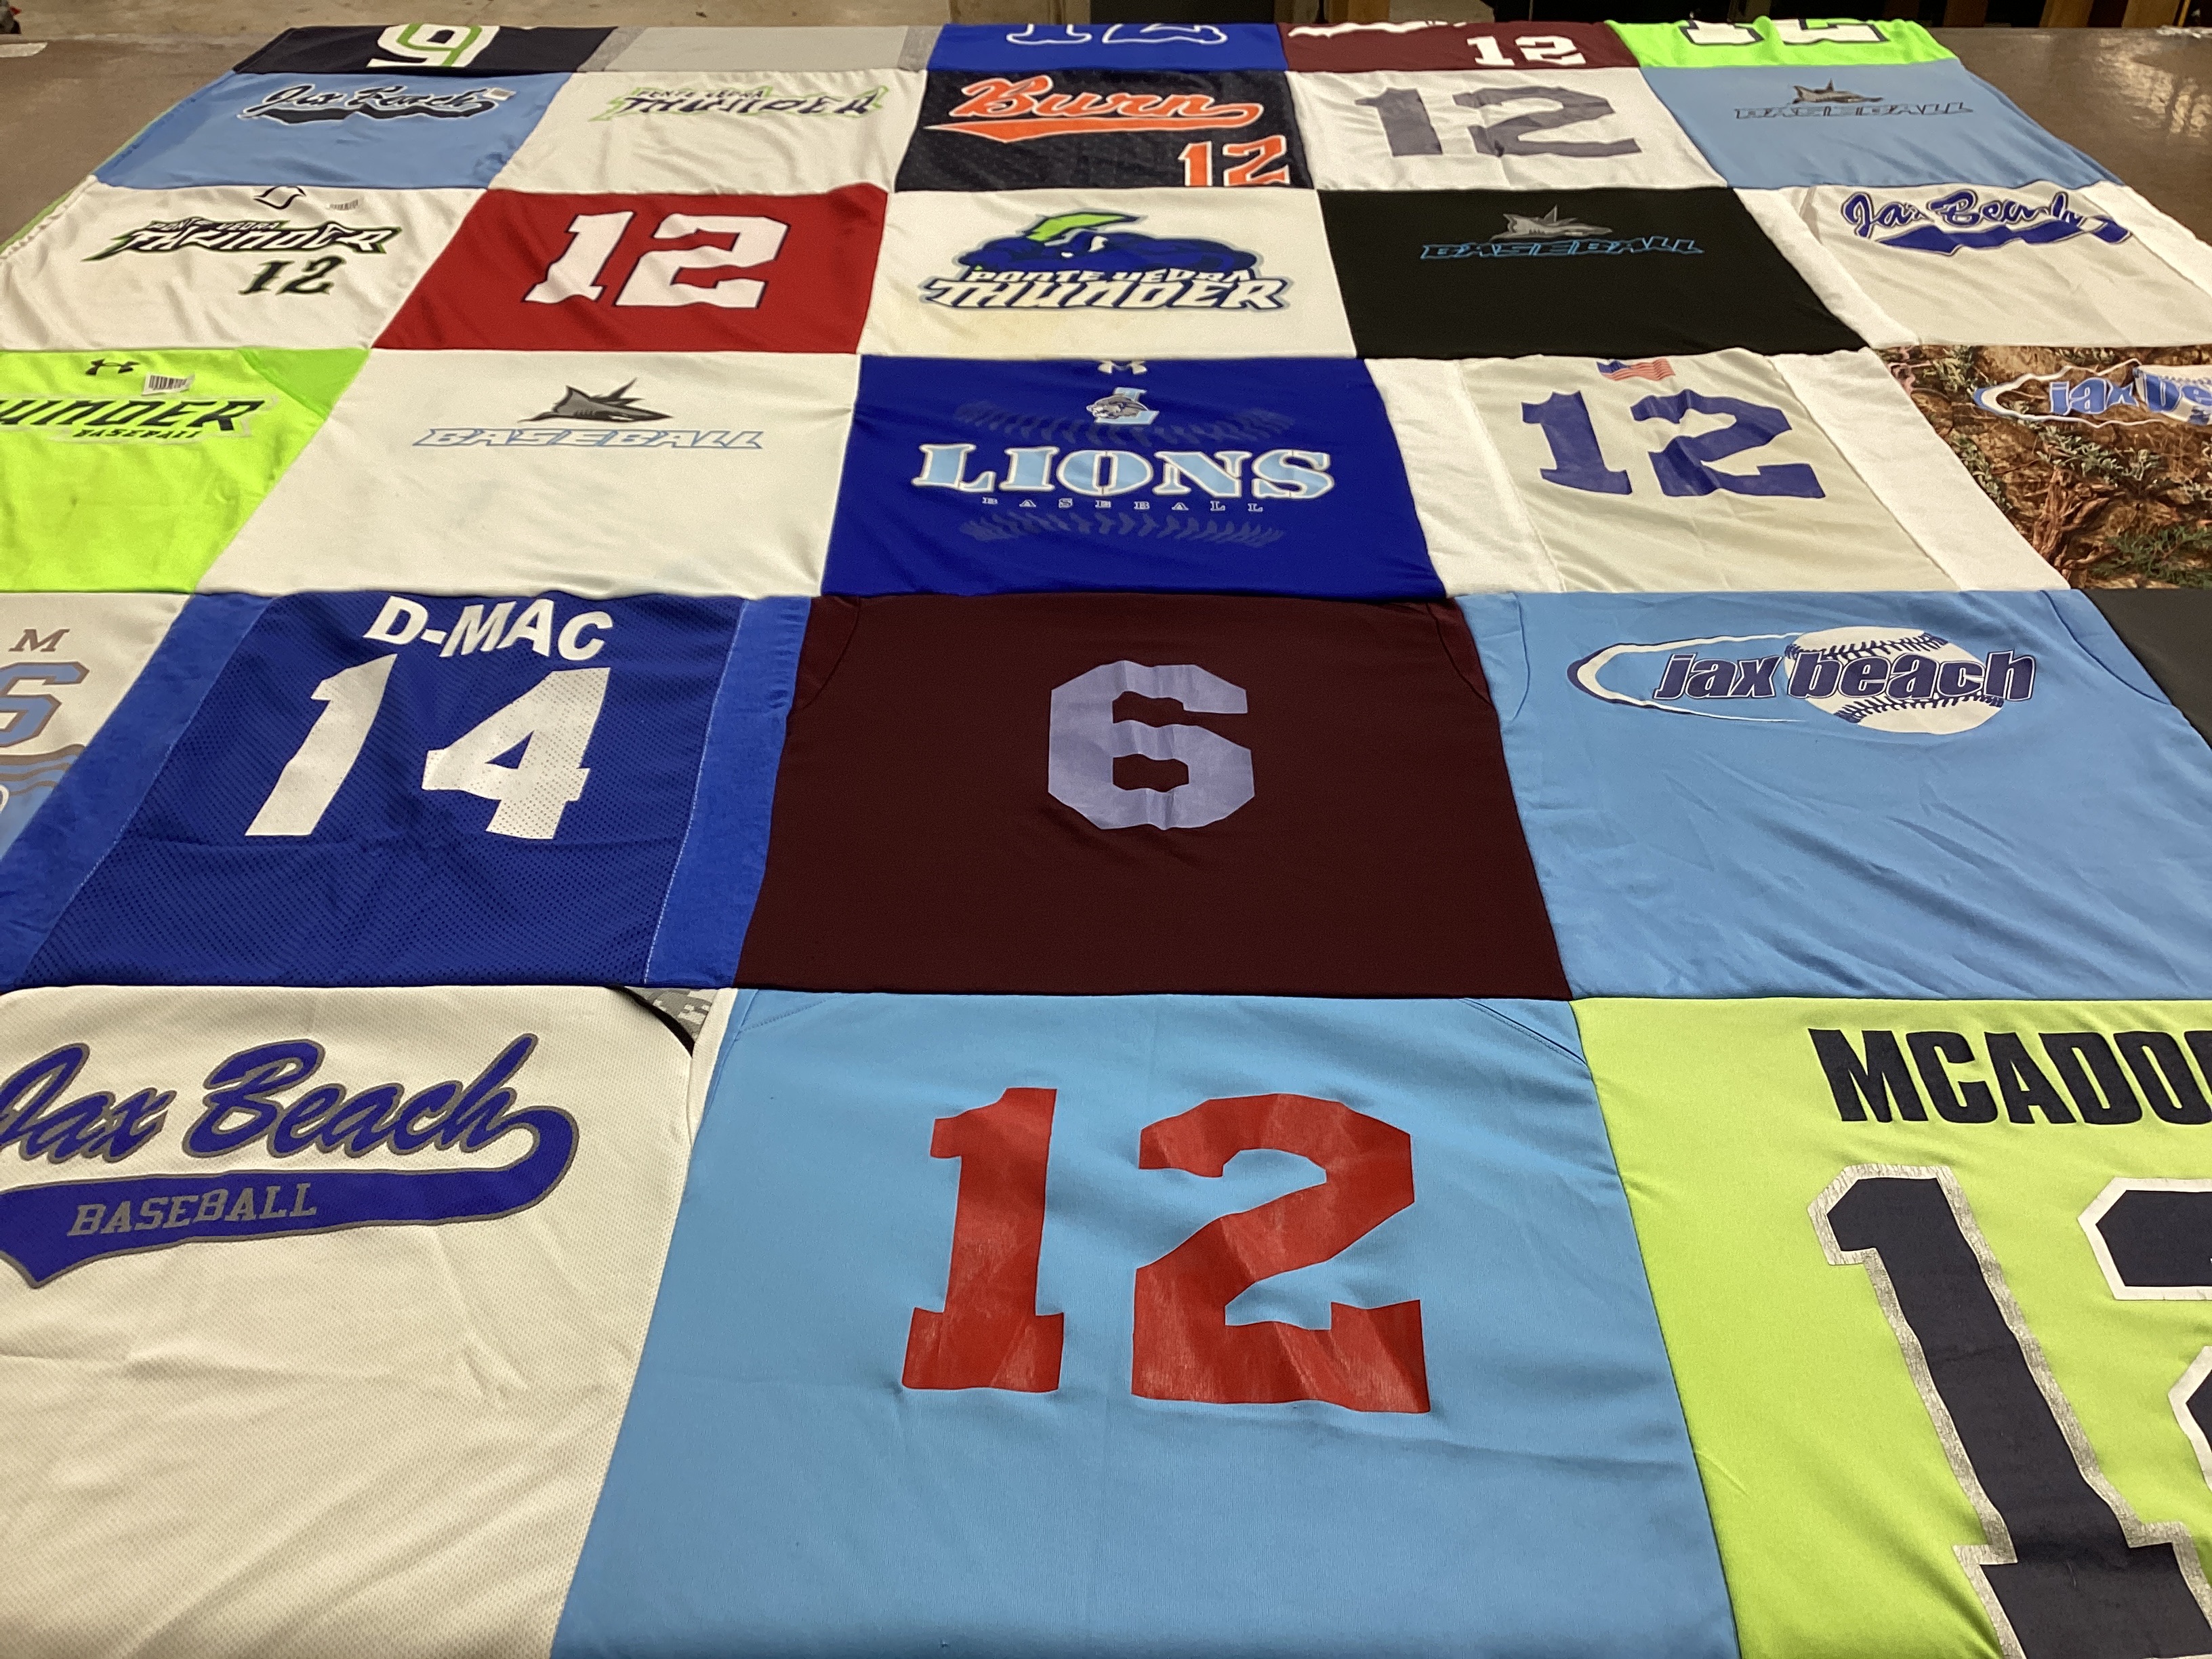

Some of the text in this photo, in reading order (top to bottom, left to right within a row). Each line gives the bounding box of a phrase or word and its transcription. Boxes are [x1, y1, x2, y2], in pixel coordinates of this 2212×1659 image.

[1467, 35, 1586, 66] 12
[949, 74, 1265, 129] Burn
[1355, 86, 1642, 157] 12
[1178, 135, 1288, 187] 12
[238, 255, 346, 295] 12
[521, 210, 791, 308] 12
[964, 268, 1254, 283] PONTE VEDRA
[923, 278, 1288, 310] THUNDER
[0, 399, 265, 431] UNDER
[411, 428, 764, 449] BASEBALL
[912, 443, 1335, 499] LIONS
[1521, 388, 1826, 499] 12
[981, 496, 1263, 513] BASEBALL
[363, 595, 613, 661] D-MAC
[1652, 649, 2036, 702] jax beach
[245, 653, 611, 840] 14
[1048, 660, 1255, 830] 6
[0, 1032, 538, 1164] Jax Beach
[66, 1183, 318, 1239] BASEBALL
[901, 1088, 1431, 1414] 12
